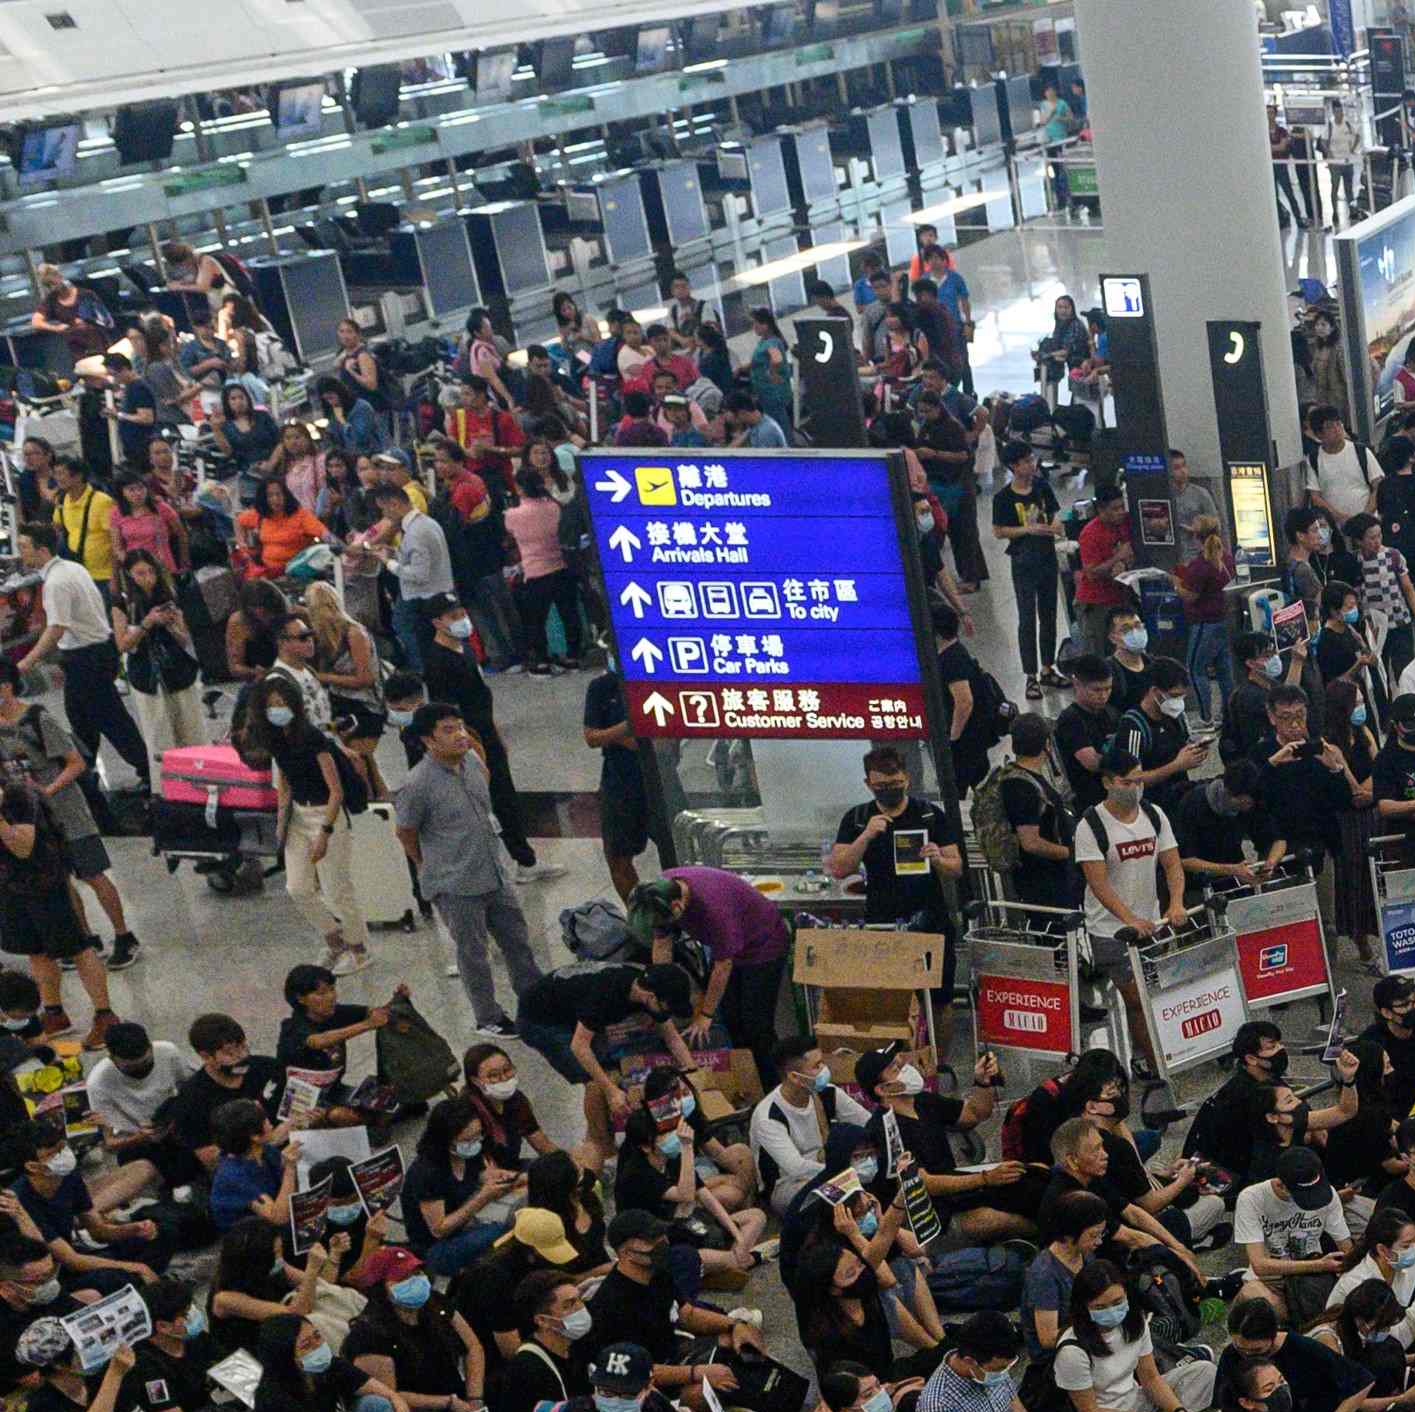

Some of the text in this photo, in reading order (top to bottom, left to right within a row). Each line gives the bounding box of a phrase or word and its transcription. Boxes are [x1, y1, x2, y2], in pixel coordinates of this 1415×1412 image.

[677, 465, 728, 488] 離港
[680, 492, 771, 509] Departures
[647, 522, 749, 545] 接機大堂
[652, 548, 749, 563] Arrivals Hall
[783, 580, 858, 602] 往市區
[785, 603, 839, 622] To city
[711, 635, 784, 657] 停車場
[713, 659, 789, 675] Car Parks
[722, 690, 820, 712] 旅客服務
[724, 713, 865, 730] Customer Service
[1391, 928, 1415, 940] TOTO
[987, 990, 1061, 1010] EXPERIENCE
[1162, 986, 1231, 1021] EXPERIENCE
